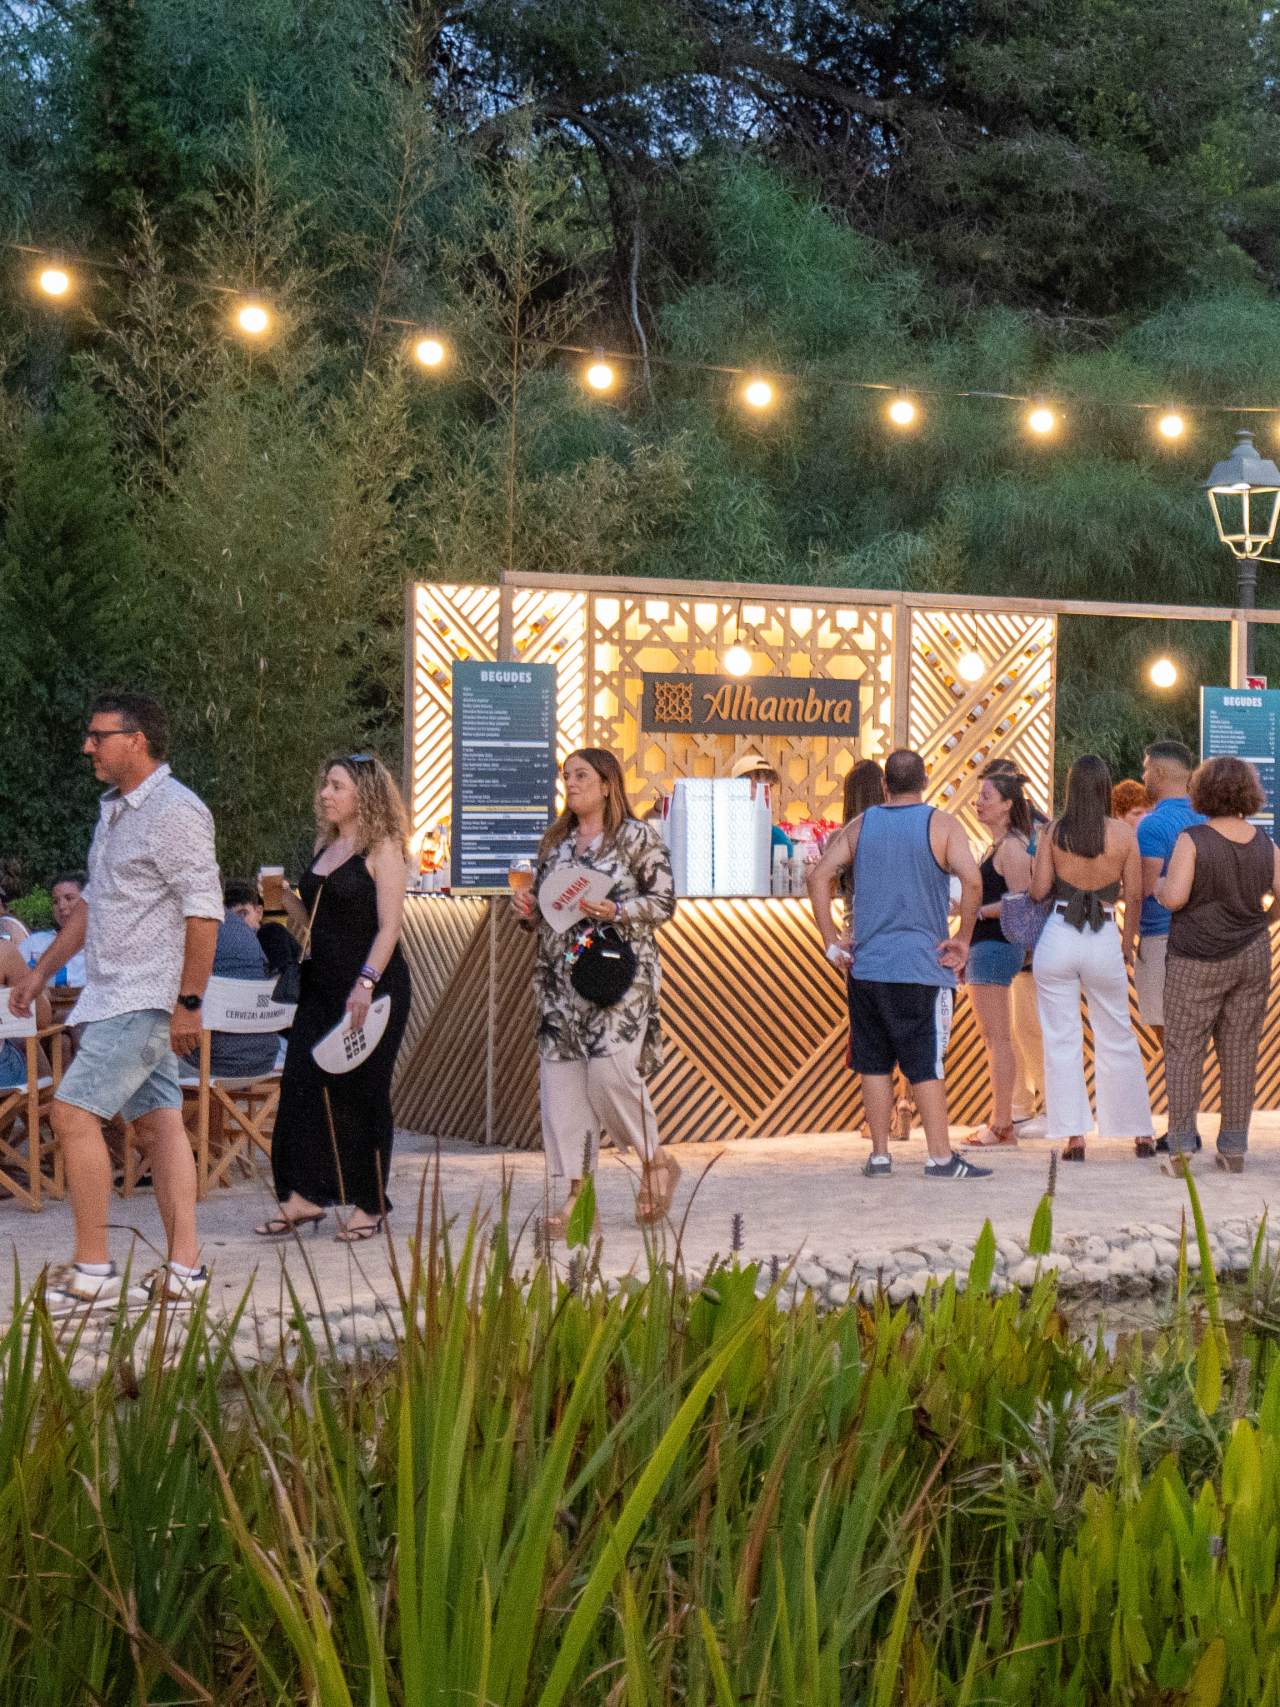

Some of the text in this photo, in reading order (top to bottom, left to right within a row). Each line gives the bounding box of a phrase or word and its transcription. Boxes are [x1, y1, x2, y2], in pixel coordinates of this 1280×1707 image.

[481, 671, 532, 683] BEGUDES
[702, 684, 852, 723] Alhambra
[1223, 696, 1263, 707] BEGUDES
[557, 876, 591, 905] YAMAHA
[225, 1010, 258, 1020] CERVEZAS
